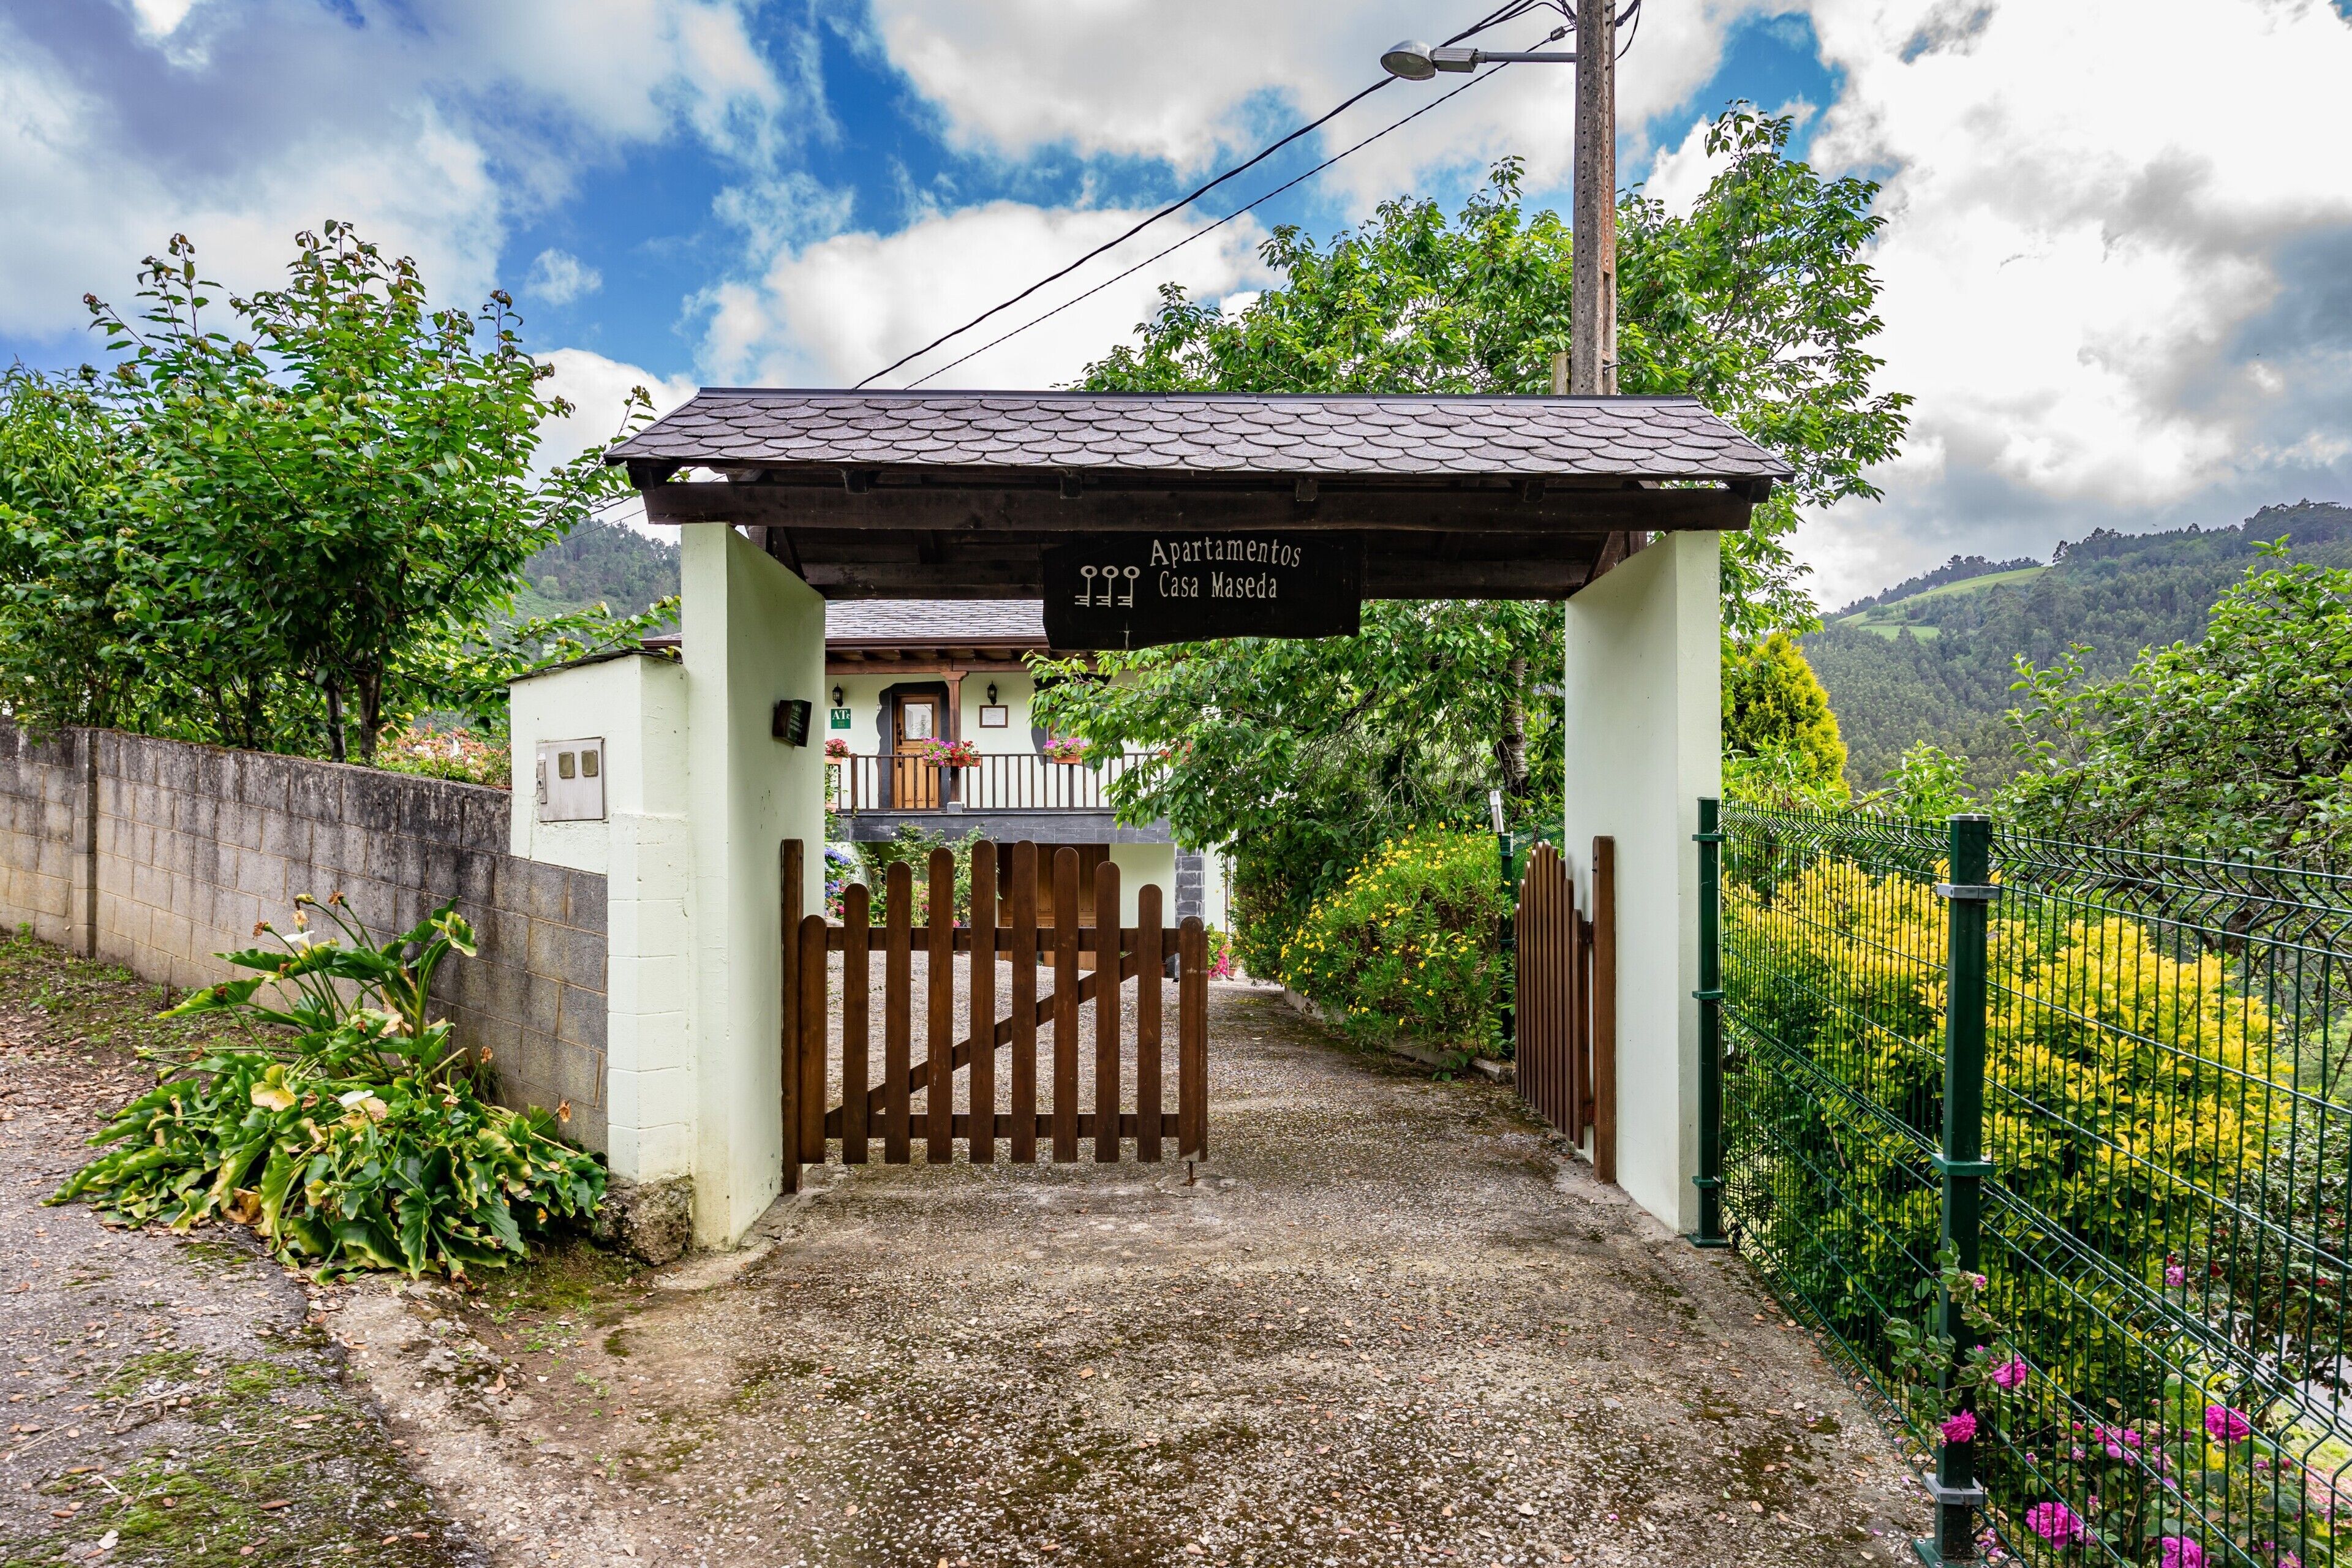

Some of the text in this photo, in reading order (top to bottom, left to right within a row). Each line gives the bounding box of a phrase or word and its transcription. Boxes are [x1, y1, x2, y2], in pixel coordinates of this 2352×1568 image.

[1150, 537, 1301, 568] Apartamentos
[1159, 570, 1277, 598] Casa Maseda
